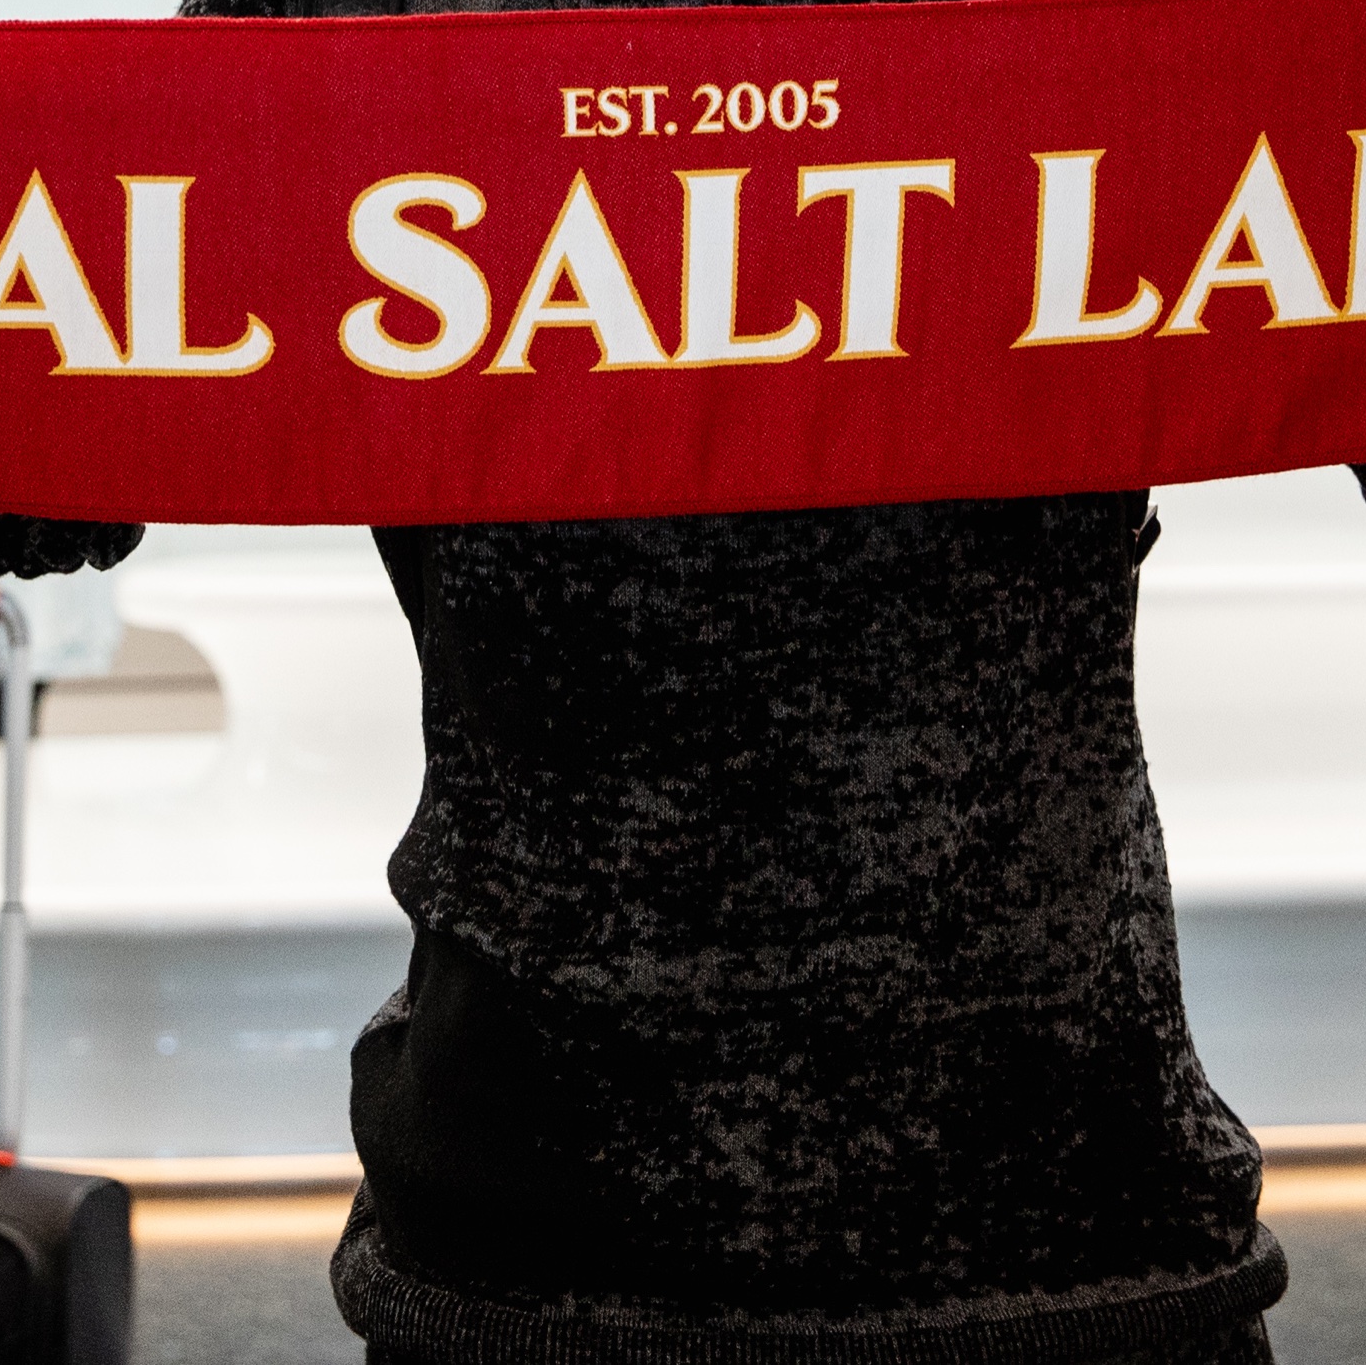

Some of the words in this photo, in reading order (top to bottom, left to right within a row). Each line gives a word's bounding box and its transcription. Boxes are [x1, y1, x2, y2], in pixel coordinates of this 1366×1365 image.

[559, 85, 678, 138] EST.
[691, 78, 842, 134] 2005
[338, 158, 956, 380] SALT
